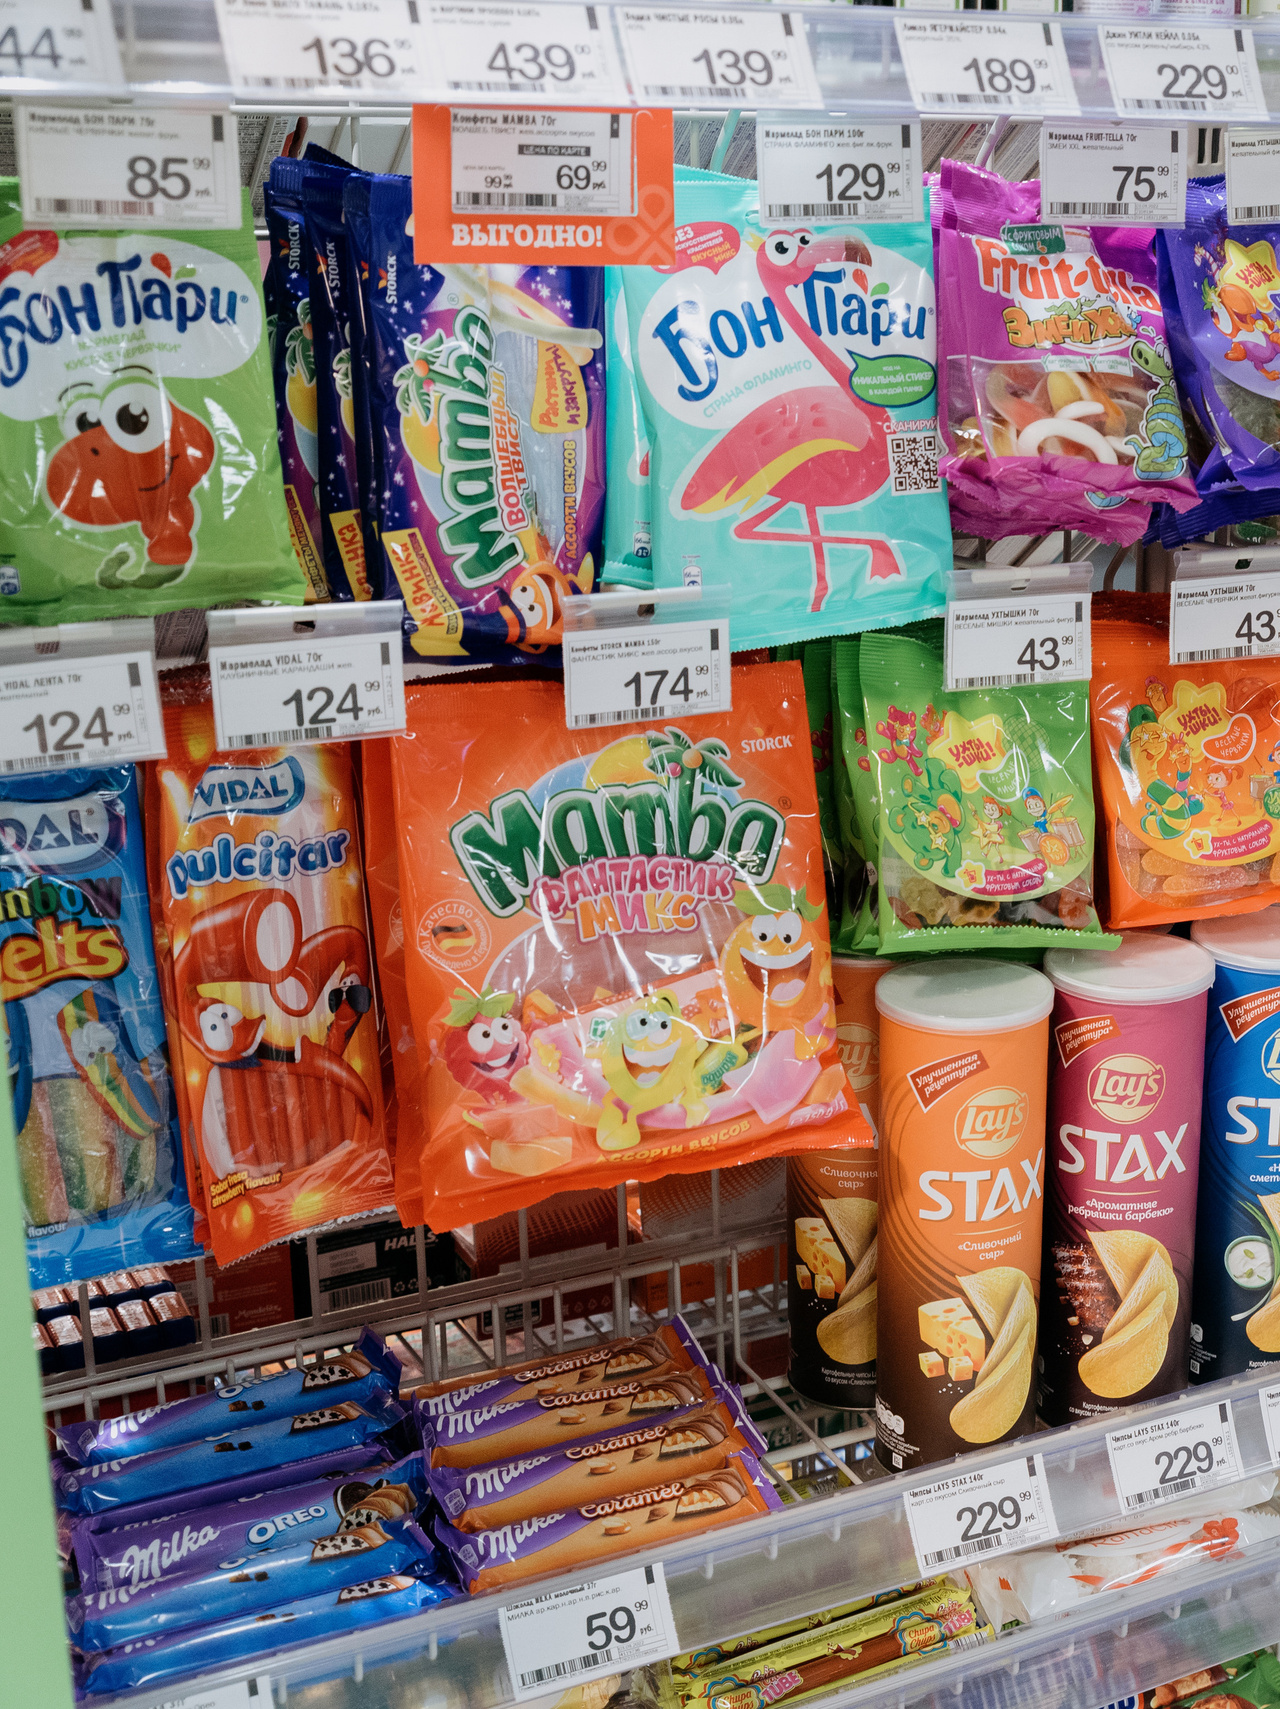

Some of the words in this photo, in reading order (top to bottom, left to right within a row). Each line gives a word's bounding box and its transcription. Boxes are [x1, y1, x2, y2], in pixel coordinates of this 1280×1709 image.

[304, 38, 396, 78] 136
[486, 43, 576, 82] 439
[693, 49, 773, 86] 139
[964, 57, 1036, 94] 189
[1156, 63, 1228, 101] 229
[452, 112, 498, 126] Конфеты
[823, 129, 845, 139] ПАРИ
[1085, 132, 1124, 143] FRUIT-TELLA
[127, 156, 191, 201] 85
[556, 164, 591, 190] 69
[816, 162, 885, 202] 129
[1112, 165, 1156, 202] 75
[288, 221, 301, 269] STORCK
[451, 223, 603, 249] ВЫГОДНО!
[329, 240, 343, 289] STORCK
[714, 249, 737, 264] МИКС
[96, 253, 237, 333] Пари
[385, 254, 397, 305] STORCK
[703, 386, 744, 418] СТРАНА
[743, 359, 813, 391] ФЛАМИНГО
[853, 374, 904, 385] УНИКАЛЬНЫЙ
[883, 417, 938, 433] СКАНИРУЙ
[490, 371, 527, 527] ВОЛШЕБНЫЙ
[563, 440, 577, 493] ВКУСОВ
[564, 493, 577, 560] АССОРТИ
[1176, 588, 1209, 601] Мармелад
[1210, 585, 1244, 598] УХТЫШКИ
[955, 611, 989, 623] Мармелад
[991, 609, 1027, 621] УХТЫШКИ
[1235, 610, 1276, 644] 43
[219, 657, 272, 672] Мармелад
[274, 654, 303, 667] VIDAL
[306, 652, 323, 664] 70г
[1017, 636, 1060, 672] 43
[4, 679, 30, 690] VIDAL
[33, 676, 64, 689] ЛЕНТА
[624, 666, 694, 707] 174
[281, 682, 365, 727] 124
[23, 705, 114, 754] 124
[741, 735, 793, 754] STORCK
[197, 774, 288, 806] VIDAL
[455, 783, 786, 916] Mamba
[535, 856, 735, 920] ФАНТАСТИК
[577, 889, 699, 942] МИКС
[1059, 1018, 1112, 1045] Улучшенная
[915, 1052, 978, 1088] Улучшенная
[1092, 1067, 1160, 1109] Lay's
[965, 1100, 1024, 1142] Lay's
[1058, 1122, 1189, 1184] STAX
[918, 1148, 1044, 1223] STAX
[1068, 1203, 1122, 1220] ребрышки
[1124, 1205, 1175, 1222] барбекю»
[1085, 1198, 1158, 1211] «Ароматные
[958, 1231, 1023, 1252] «Сливочный
[978, 1248, 1005, 1262] сыр»
[539, 1381, 641, 1410] Caramel
[1111, 1432, 1132, 1443] Чипсы
[1132, 1427, 1150, 1439] LAYS
[1150, 1422, 1165, 1435] STAX
[1166, 1418, 1180, 1429] 140г
[466, 1453, 552, 1499] Milka
[565, 1424, 669, 1460] Caramel
[1154, 1440, 1215, 1486] 229
[1211, 1436, 1223, 1448] 99
[910, 1486, 931, 1498] Чипсы
[932, 1483, 950, 1495] LAYS
[951, 1478, 968, 1491] STAX
[969, 1473, 984, 1486] 140г
[249, 1504, 326, 1547] OREO
[479, 1509, 566, 1559] Milka
[580, 1481, 685, 1518] Caramel
[956, 1495, 1023, 1542] 229
[1019, 1491, 1032, 1502] 99
[507, 1609, 534, 1622] МИЛКА
[586, 1606, 636, 1650] 59
[634, 1600, 649, 1612] 99
[908, 1623, 936, 1640] Chupa
[908, 1632, 937, 1650] Chups
[761, 1670, 802, 1703] TUBE
